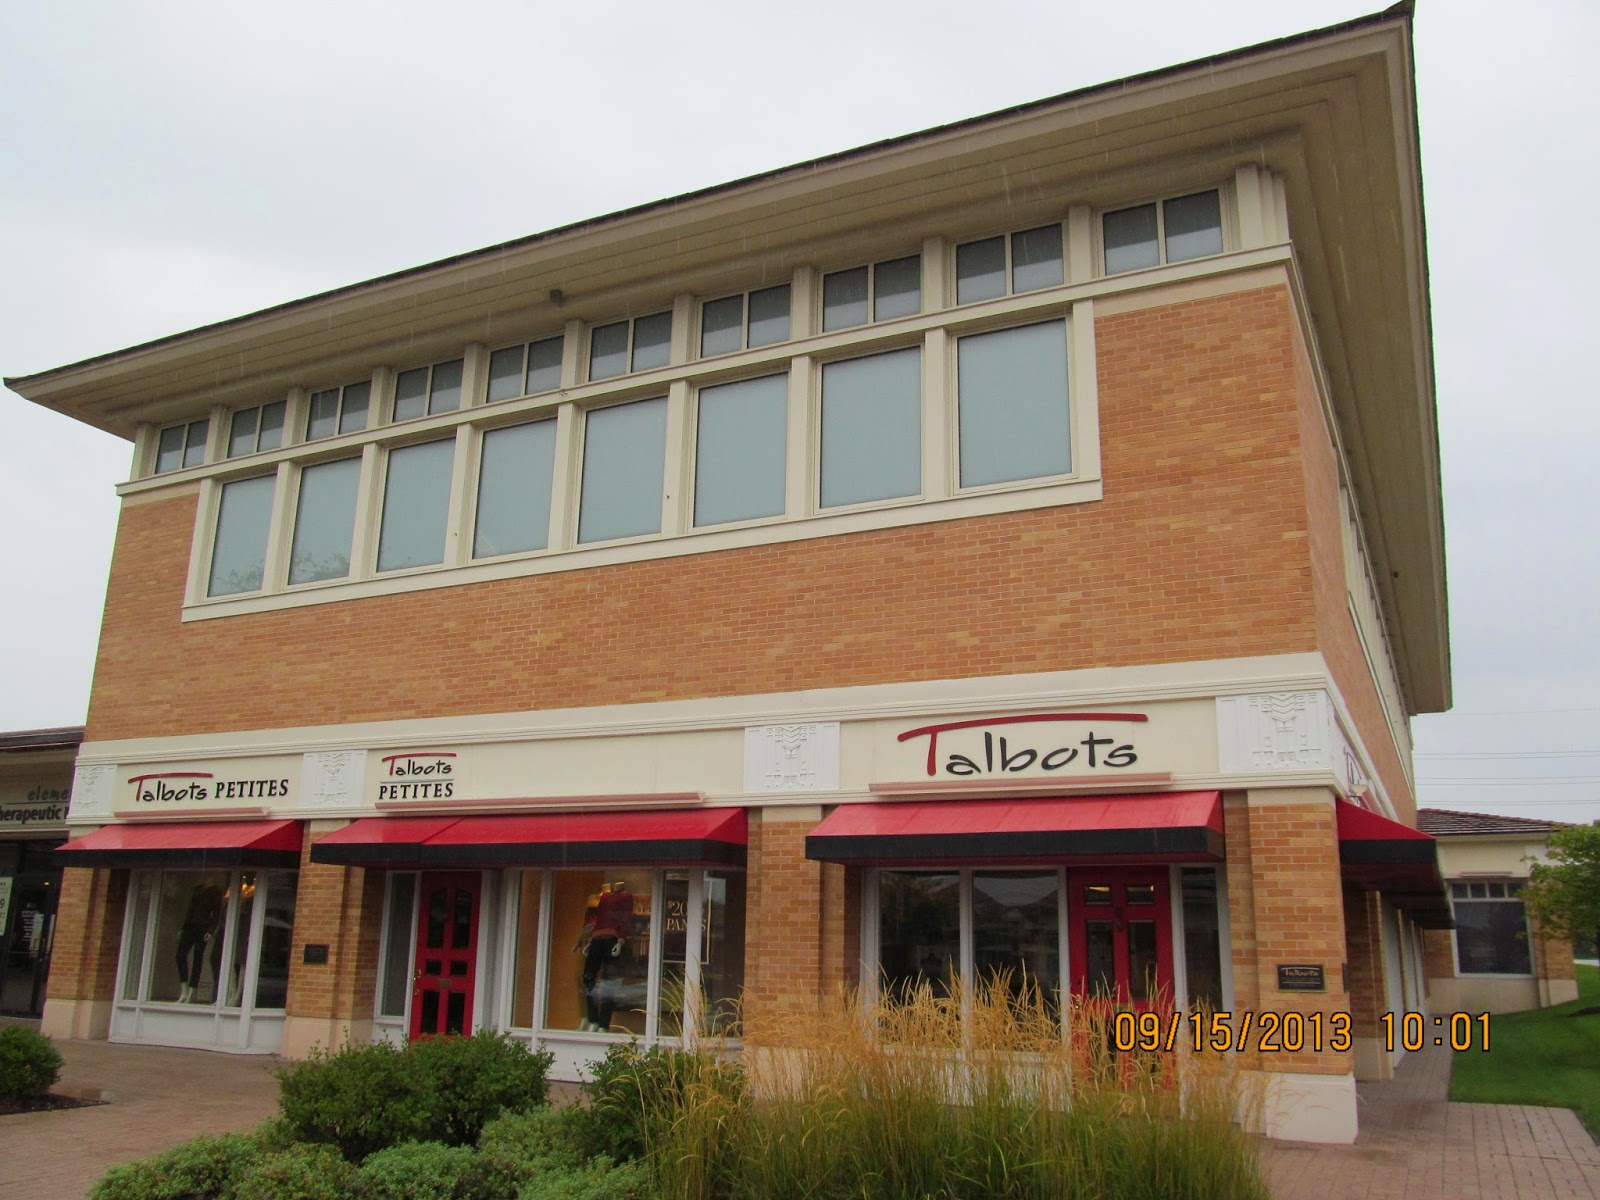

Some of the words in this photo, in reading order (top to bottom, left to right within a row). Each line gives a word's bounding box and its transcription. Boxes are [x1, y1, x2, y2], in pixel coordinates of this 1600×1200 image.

[897, 713, 1148, 776] Talbots
[382, 753, 457, 776] Talbots
[27, 786, 71, 801] eleme
[128, 772, 213, 801] Talbots
[215, 779, 289, 799] PETITES
[379, 783, 454, 799] PETITES
[666, 918, 706, 931] PANS
